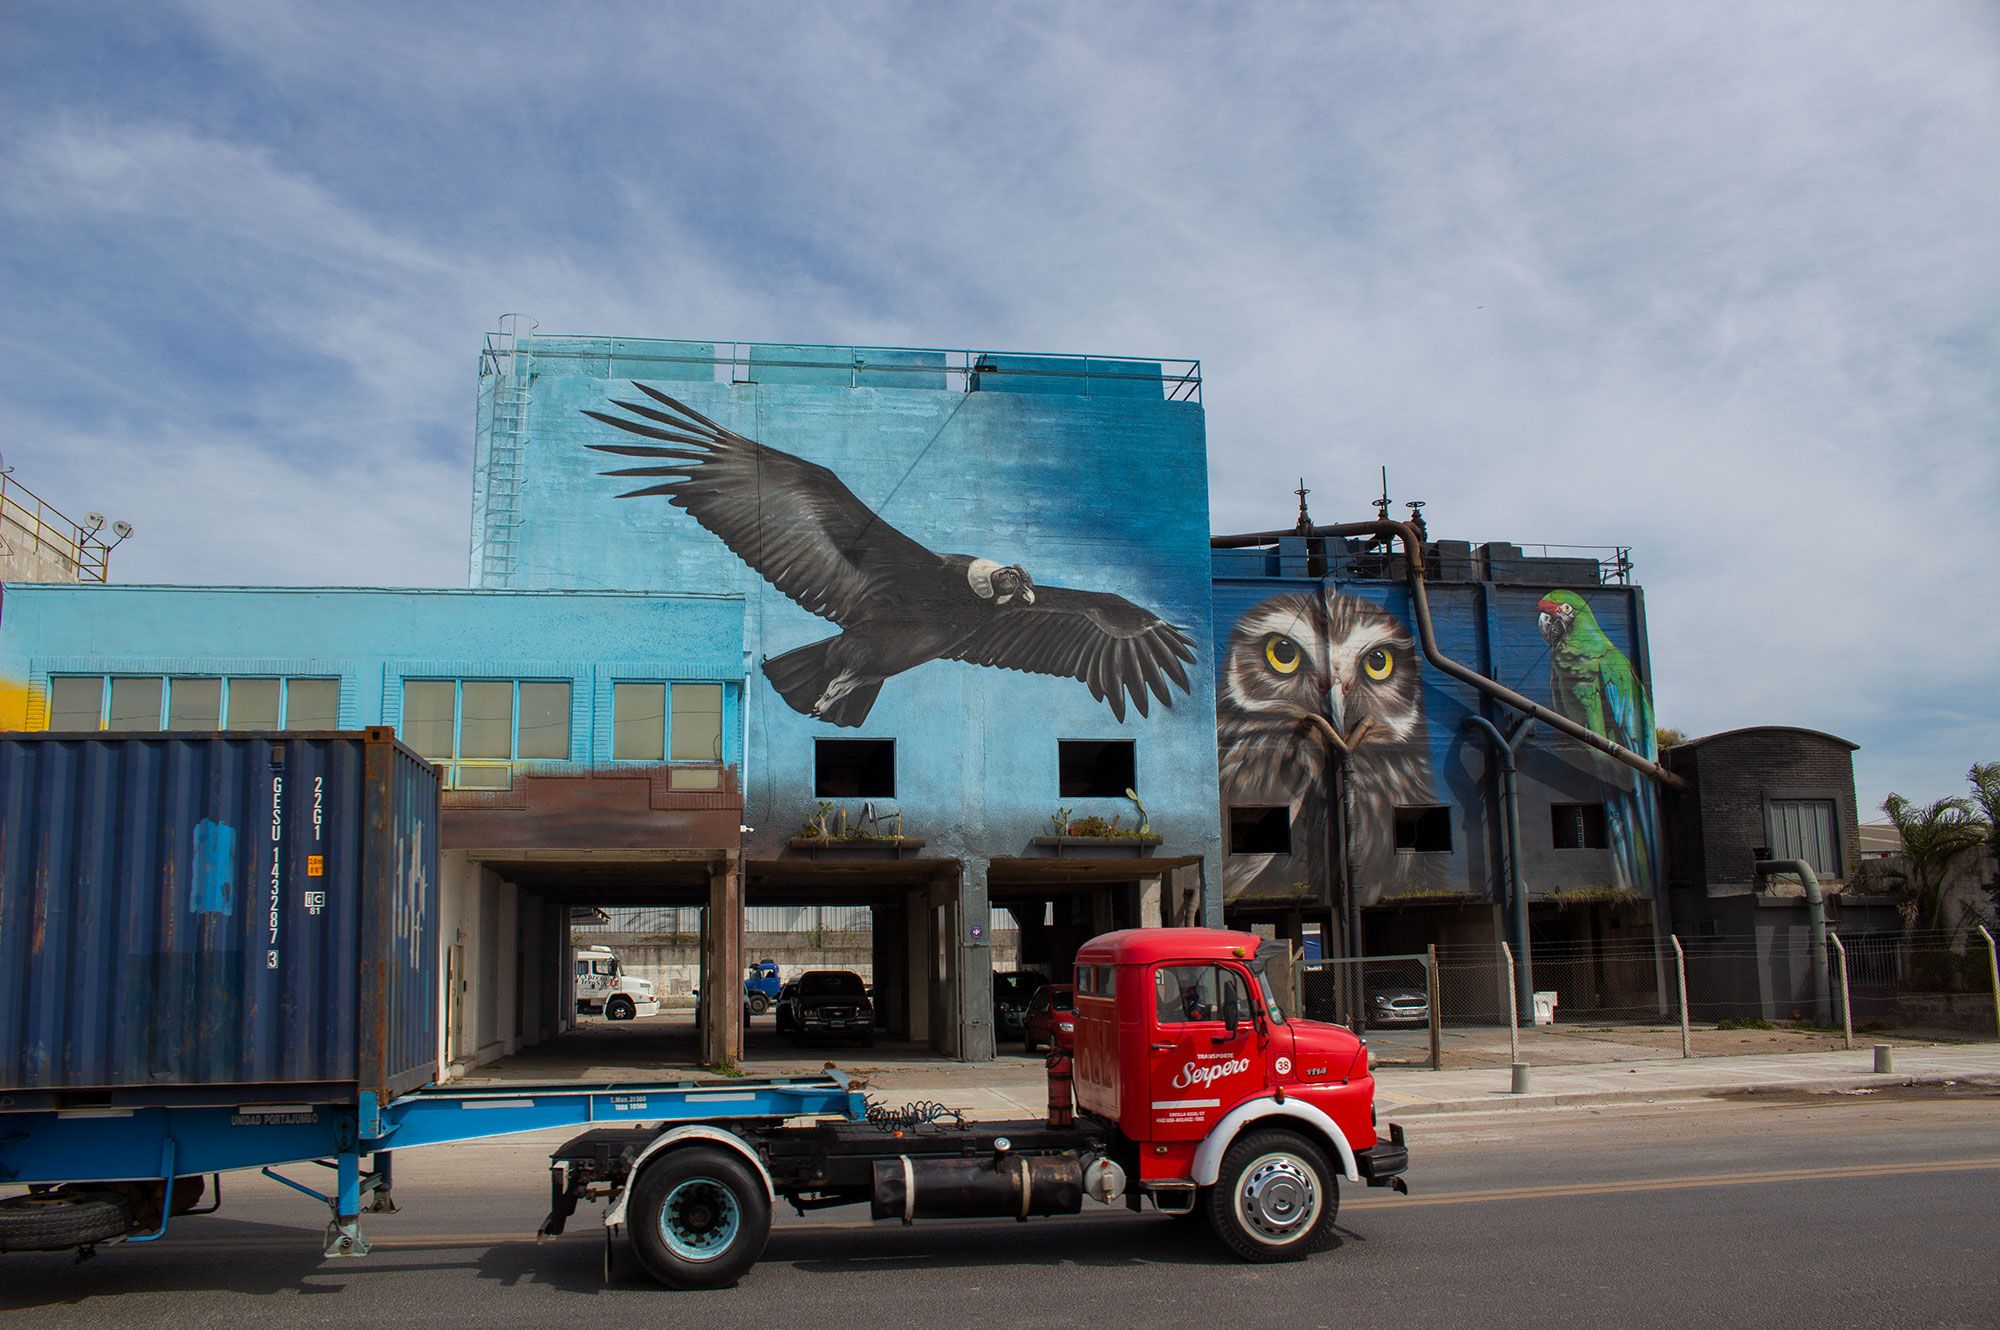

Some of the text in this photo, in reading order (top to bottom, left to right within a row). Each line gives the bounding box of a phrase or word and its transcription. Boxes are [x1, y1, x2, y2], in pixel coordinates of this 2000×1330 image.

[271, 777, 282, 841] GESU
[313, 777, 322, 840] 22G1
[270, 847, 280, 944] 143287
[1172, 1058, 1250, 1089] Serpero
[1277, 1061, 1290, 1071] 38
[1306, 1067, 1327, 1076] 1114
[231, 1113, 318, 1125] UNIDAD PORTAJUMBO
